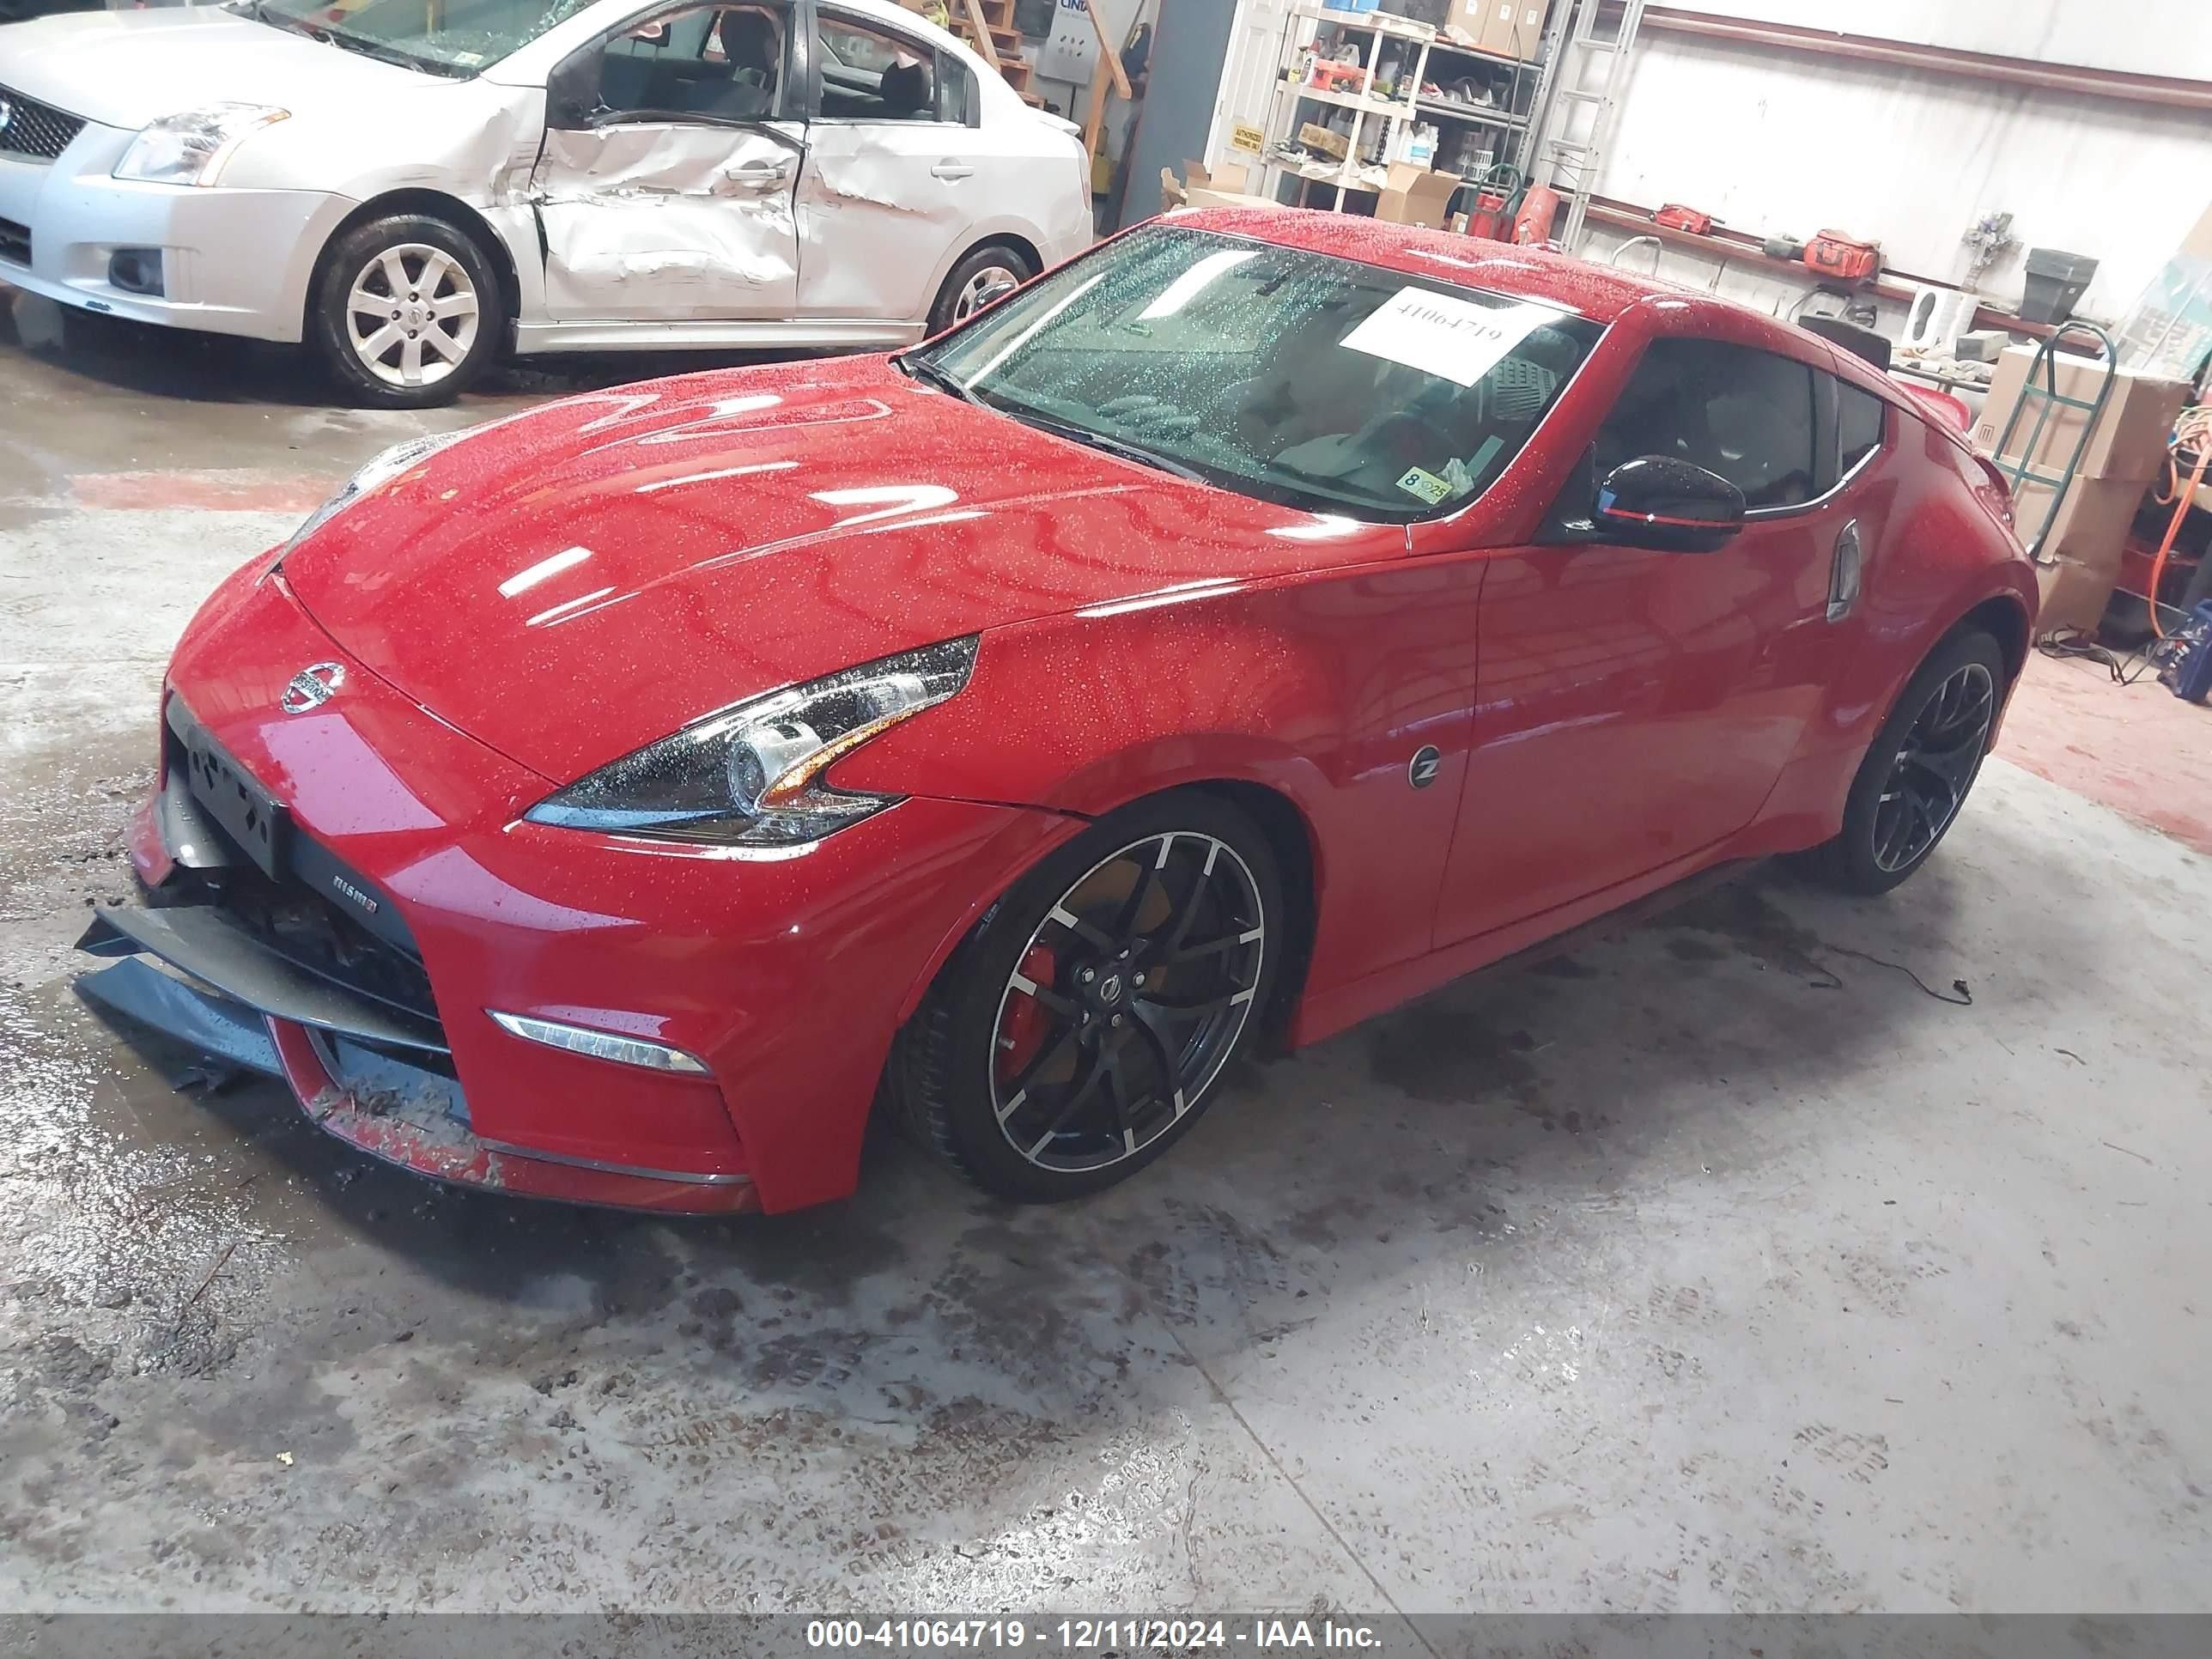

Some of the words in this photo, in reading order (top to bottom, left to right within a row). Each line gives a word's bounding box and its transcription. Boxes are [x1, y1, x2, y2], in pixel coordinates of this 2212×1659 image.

[1396, 304, 1503, 340] 41064719
[1405, 474, 1419, 486] 8
[1430, 484, 1446, 497] 25
